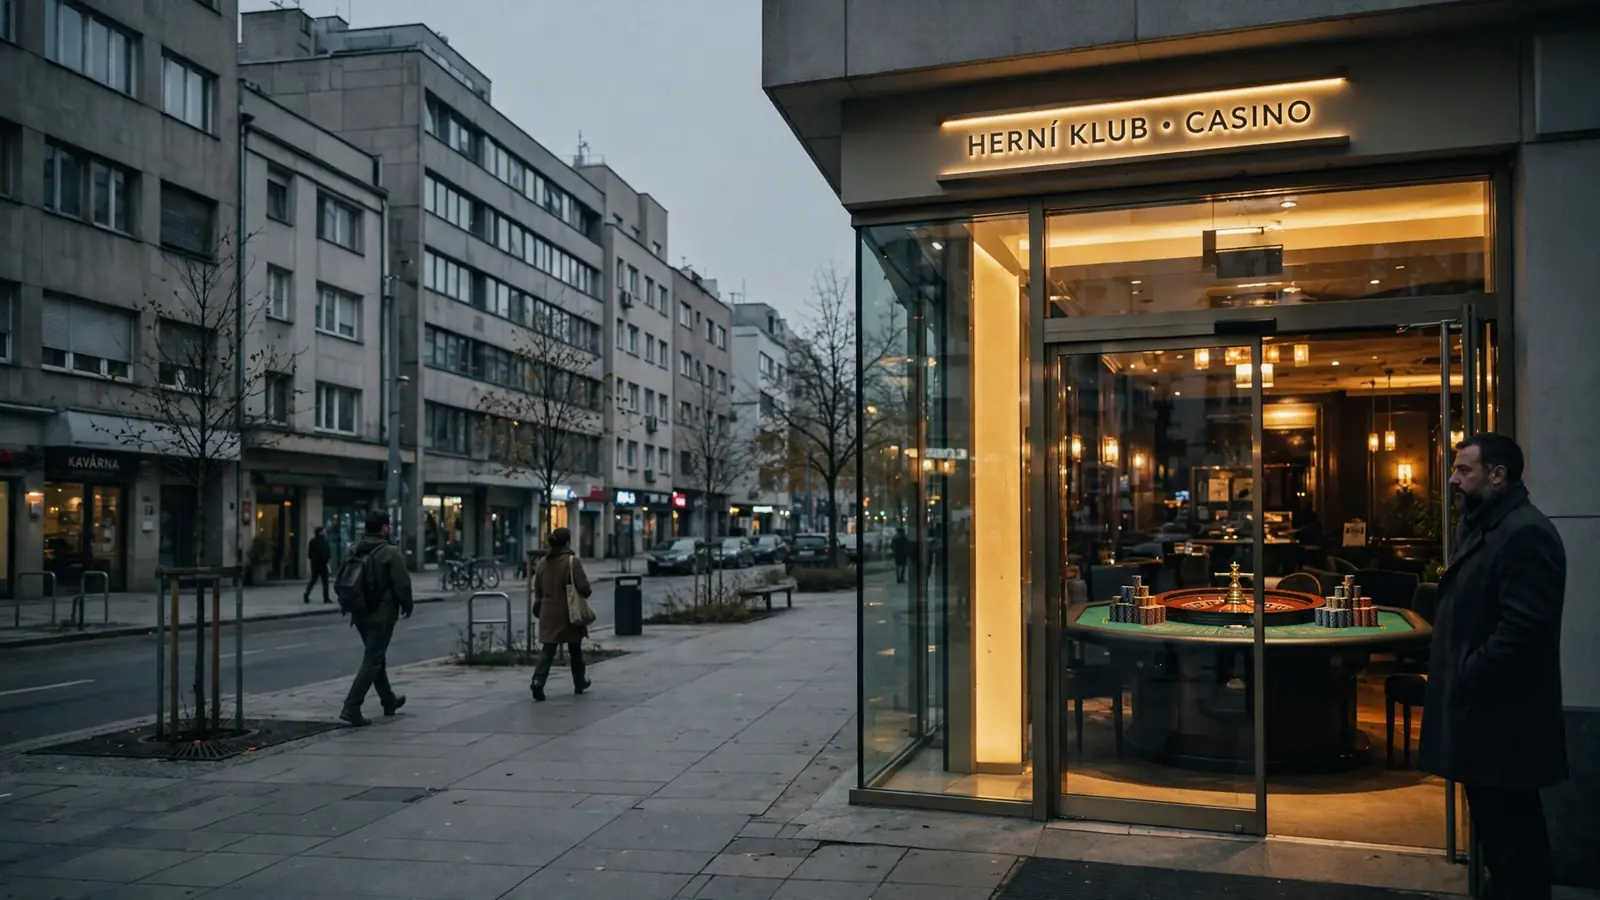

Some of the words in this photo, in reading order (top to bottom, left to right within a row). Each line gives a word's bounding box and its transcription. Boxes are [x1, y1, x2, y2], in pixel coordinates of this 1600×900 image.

[968, 120, 1058, 156] HERNÍ
[1070, 117, 1148, 145] KLUB
[1186, 100, 1311, 133] CASINO
[68, 453, 119, 469] KAVÁRNA
